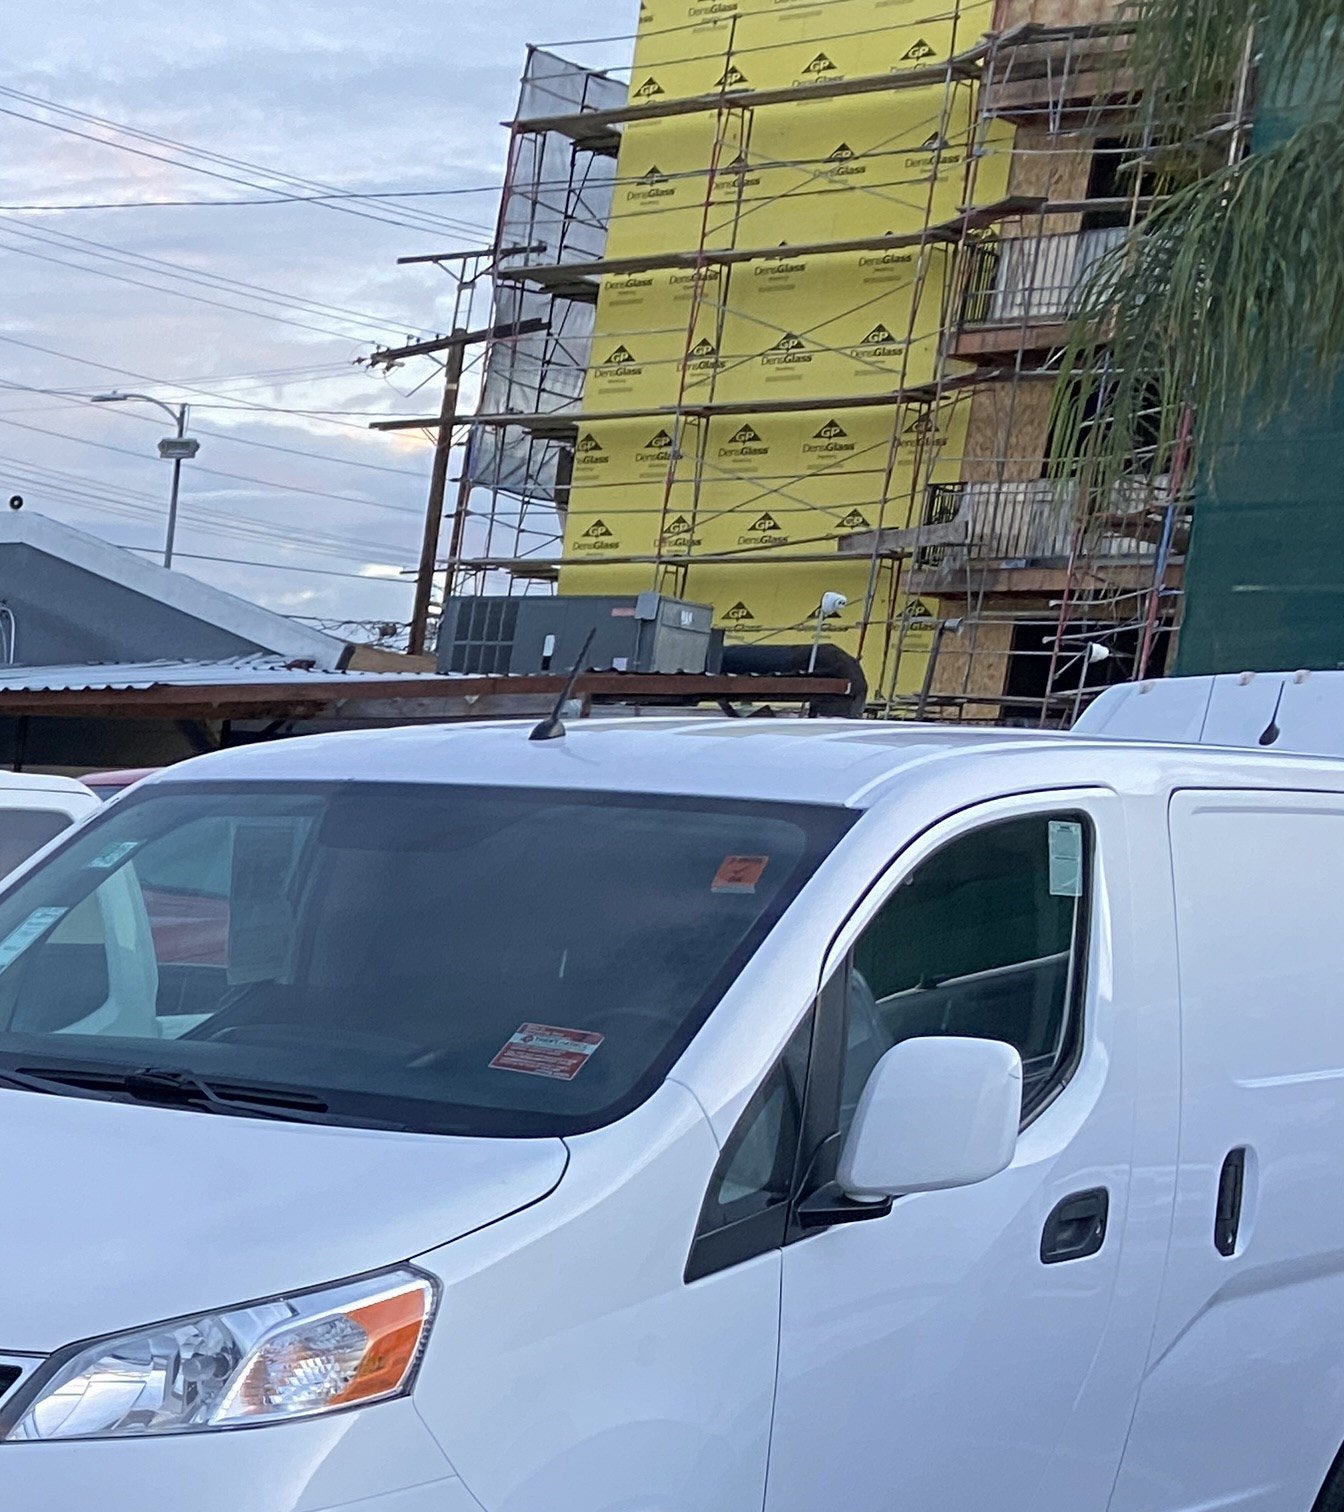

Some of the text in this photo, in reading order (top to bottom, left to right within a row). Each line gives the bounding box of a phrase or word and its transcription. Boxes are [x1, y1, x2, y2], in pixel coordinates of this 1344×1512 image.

[868, 332, 889, 342] GP
[779, 340, 798, 350] GP
[693, 346, 712, 356] GP
[611, 352, 629, 362] GP
[736, 431, 755, 441] GP
[820, 427, 841, 437] GP
[578, 440, 596, 450] GP
[652, 437, 670, 447] GP
[755, 519, 774, 529] GP
[843, 516, 863, 526] GP
[588, 527, 606, 536] GP
[670, 523, 688, 533] GP
[729, 608, 747, 618] GP
